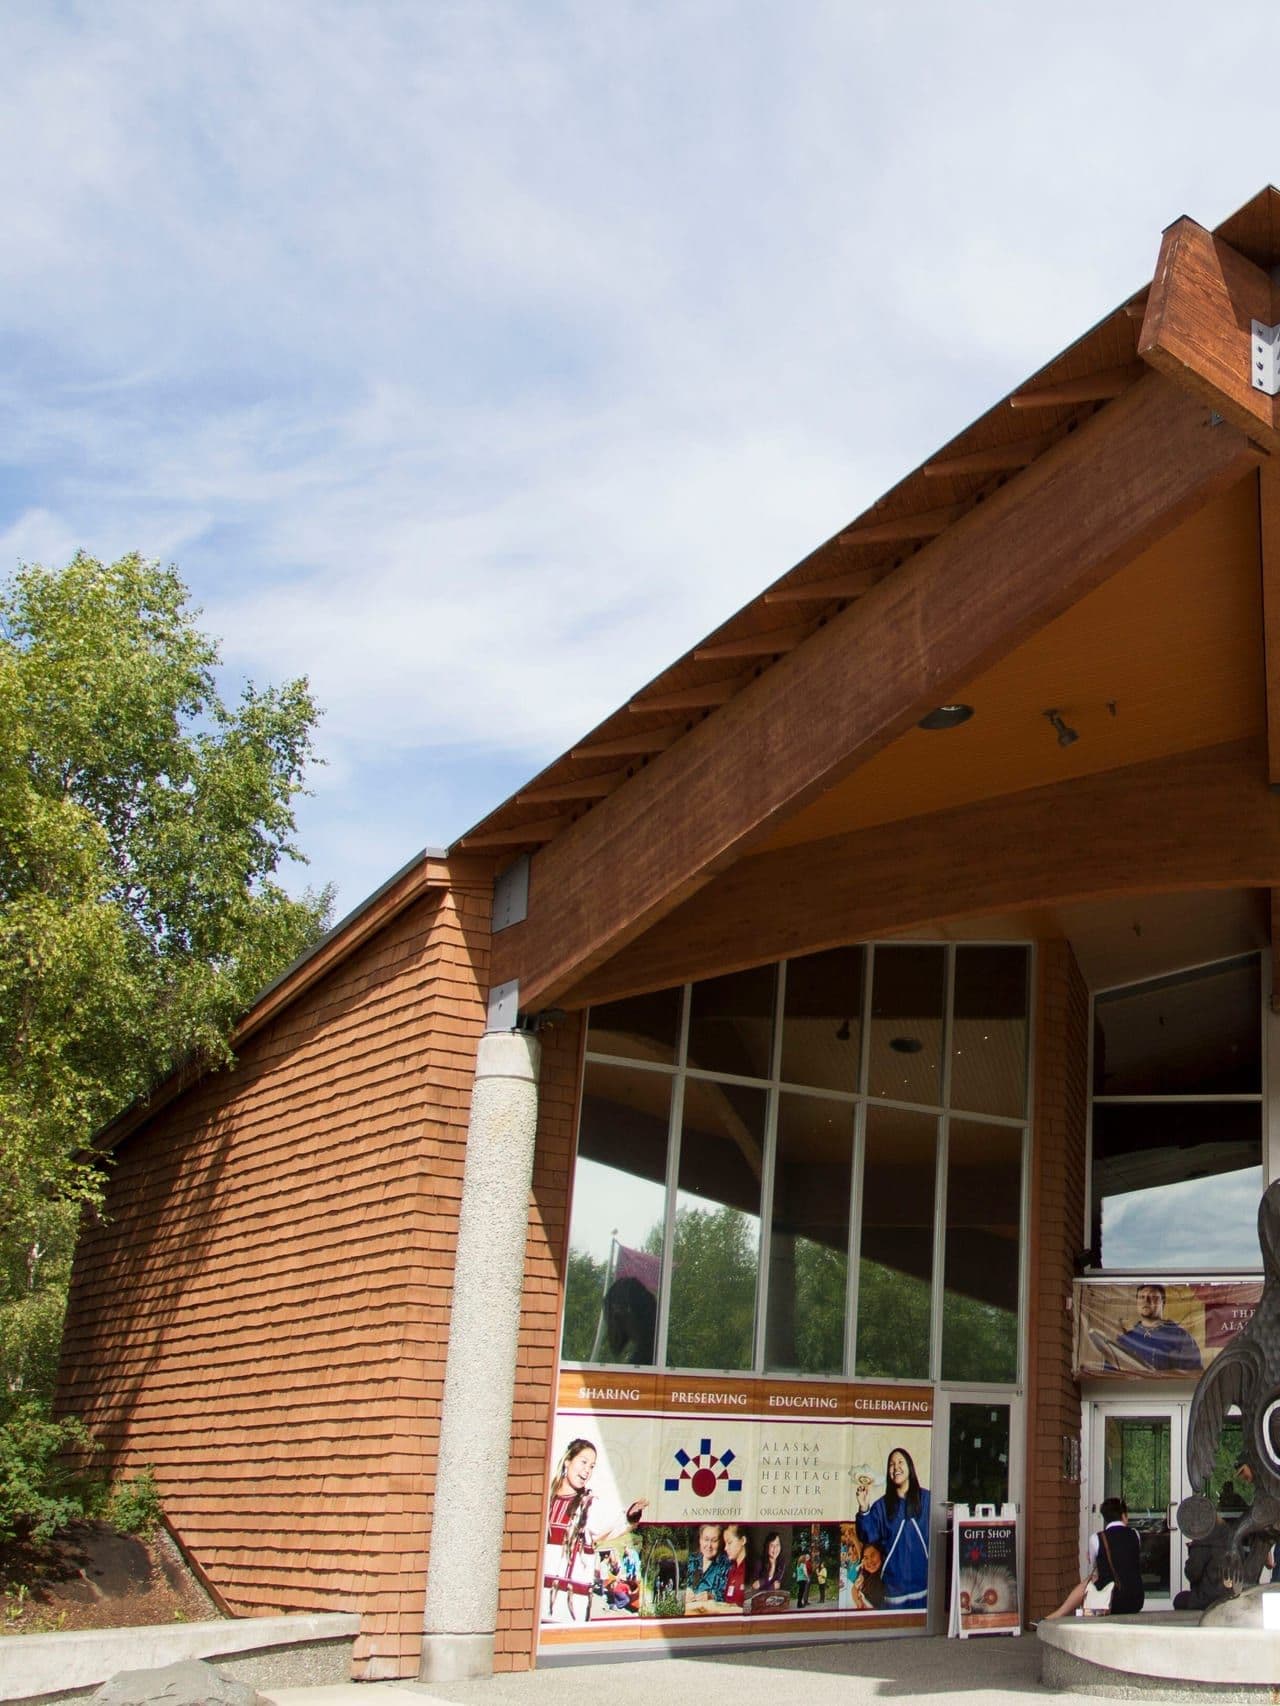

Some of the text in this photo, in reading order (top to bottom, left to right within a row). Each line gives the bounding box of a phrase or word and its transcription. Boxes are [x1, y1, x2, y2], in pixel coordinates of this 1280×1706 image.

[578, 1387, 929, 1412] SHARING PRESERVING EDUCATING CELEBRATING
[762, 1442, 820, 1452] ALASKA
[762, 1456, 820, 1467] NATIVE
[761, 1470, 840, 1481] HERITAGE
[760, 1484, 822, 1495] CENTER
[691, 1507, 742, 1517] NONPROFIT
[759, 1508, 824, 1516] ORGANIZATION
[964, 1528, 1012, 1540] GIFT SHOP
